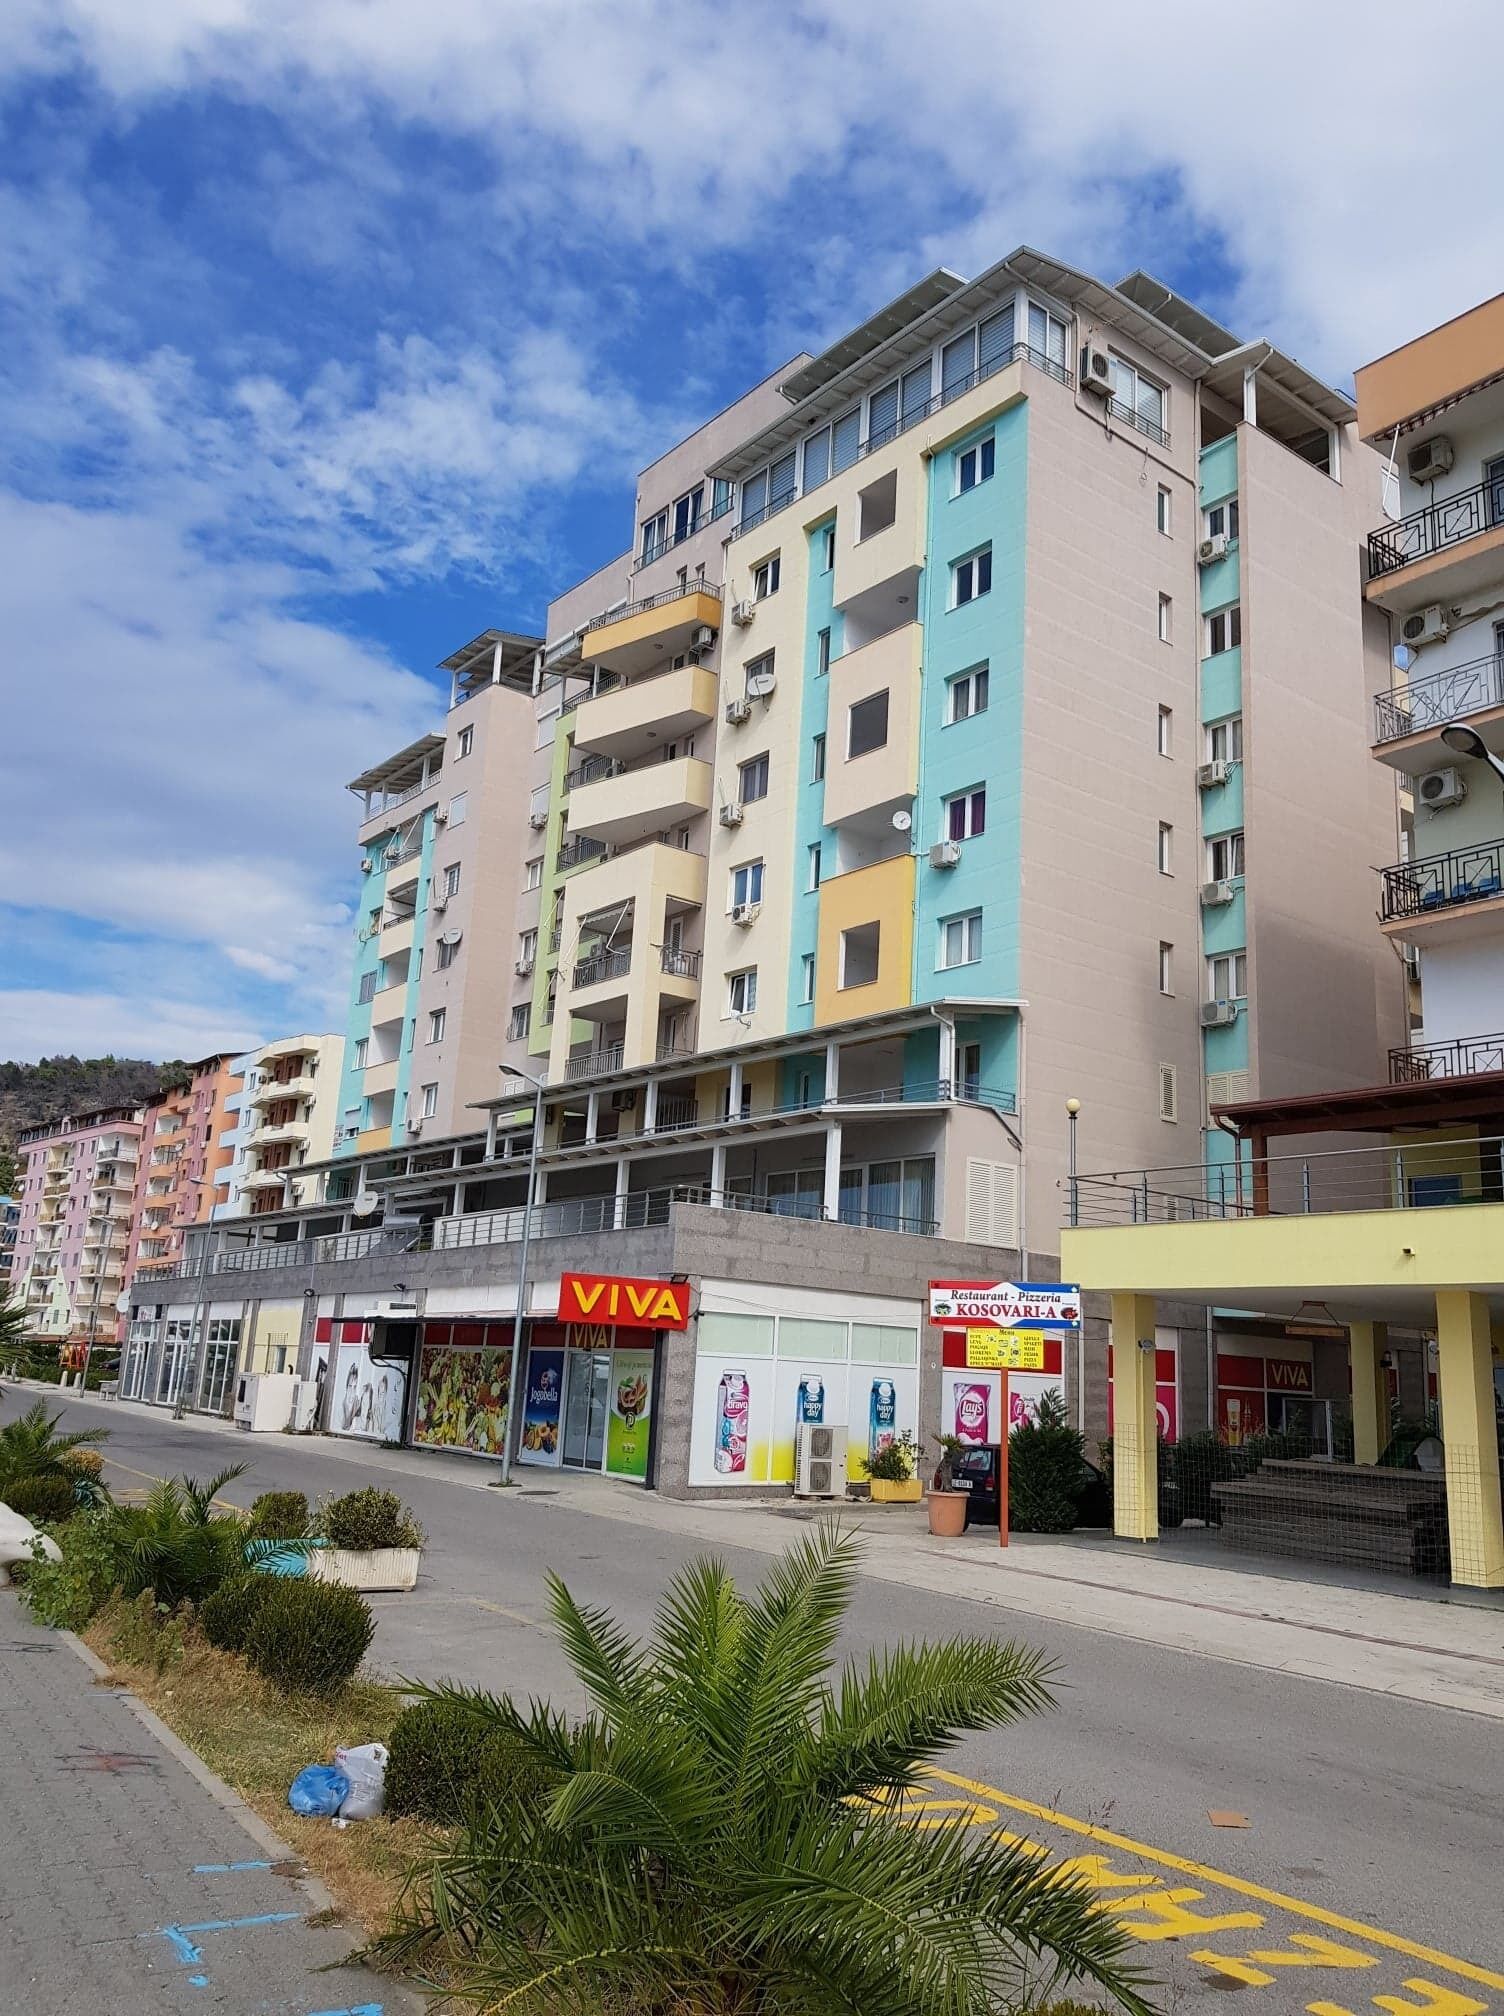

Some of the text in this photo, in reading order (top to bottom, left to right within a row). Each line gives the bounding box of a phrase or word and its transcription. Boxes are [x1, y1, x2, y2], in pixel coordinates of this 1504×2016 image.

[572, 1281, 683, 1321] VIVA
[951, 1290, 1008, 1301] Restaurant
[1017, 1292, 1061, 1303] Pizzeria
[957, 1303, 1057, 1319] KOSOVARI-A
[574, 1323, 608, 1348] VIVA
[1271, 1363, 1309, 1387] VIVA
[529, 1386, 558, 1405] Jogobella
[803, 1402, 822, 1412] happy
[807, 1409, 819, 1418] day
[876, 1403, 894, 1413] happy
[961, 1399, 983, 1419] Lay's
[880, 1411, 891, 1420] day
